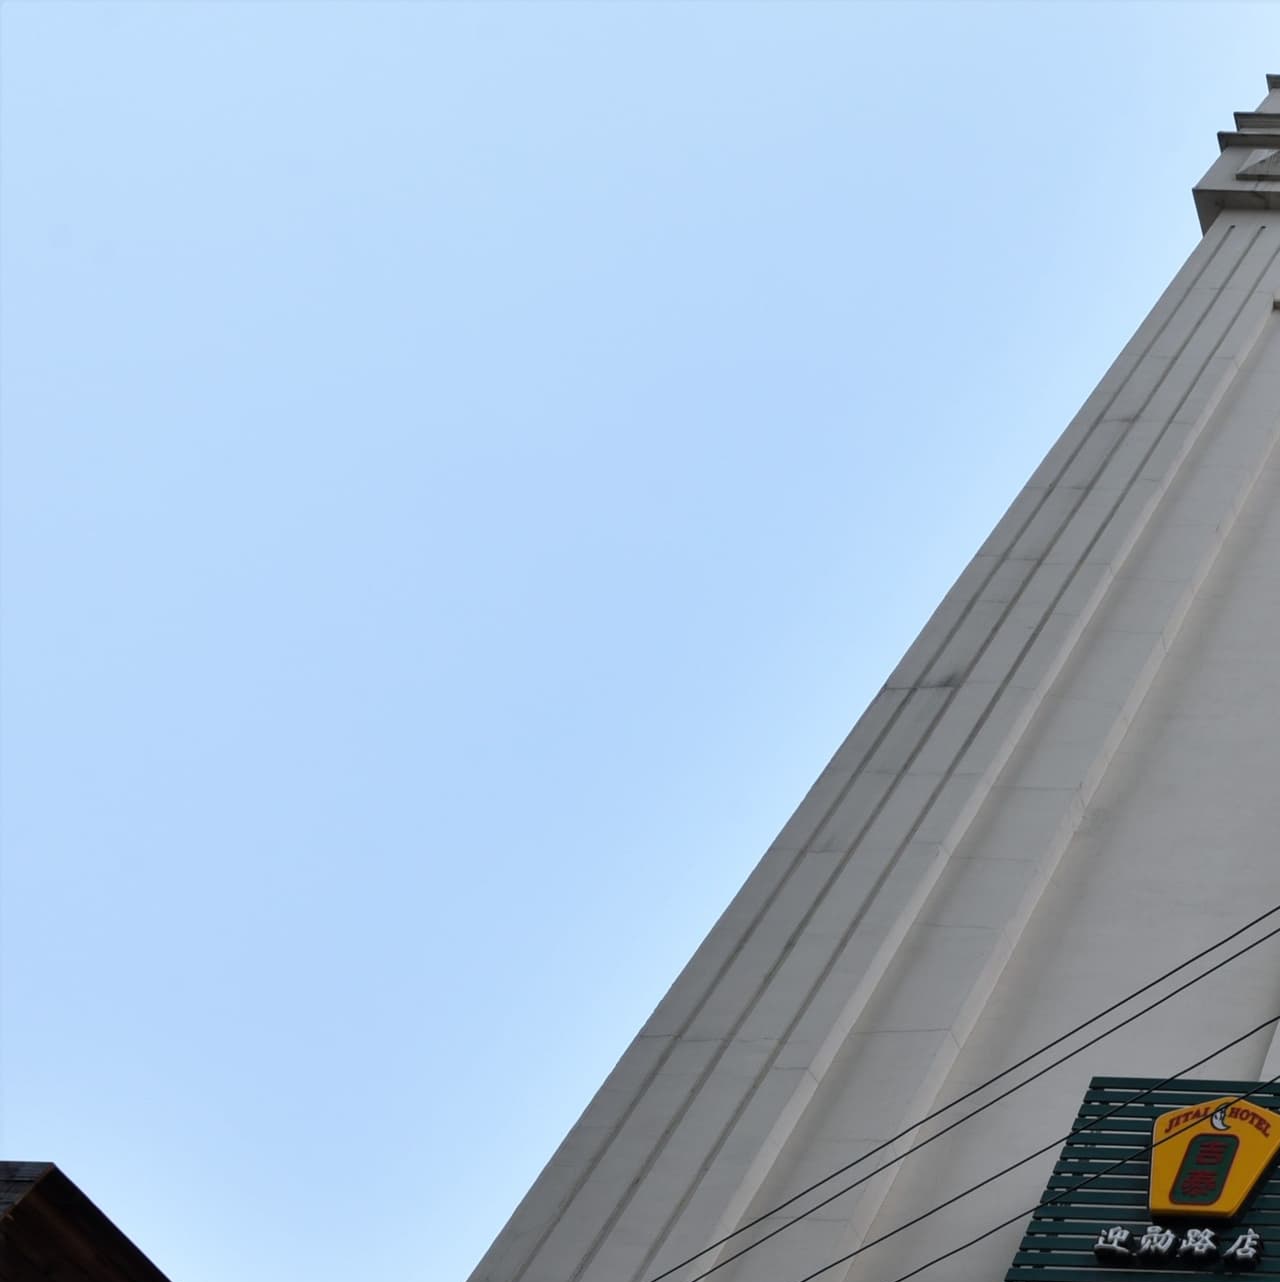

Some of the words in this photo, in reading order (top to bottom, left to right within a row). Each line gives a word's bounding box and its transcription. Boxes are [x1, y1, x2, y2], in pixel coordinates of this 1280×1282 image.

[1228, 1106, 1272, 1139] HOTEL
[1181, 1139, 1232, 1197] 吉泰
[1093, 1225, 1261, 1259] 迎勋路店
